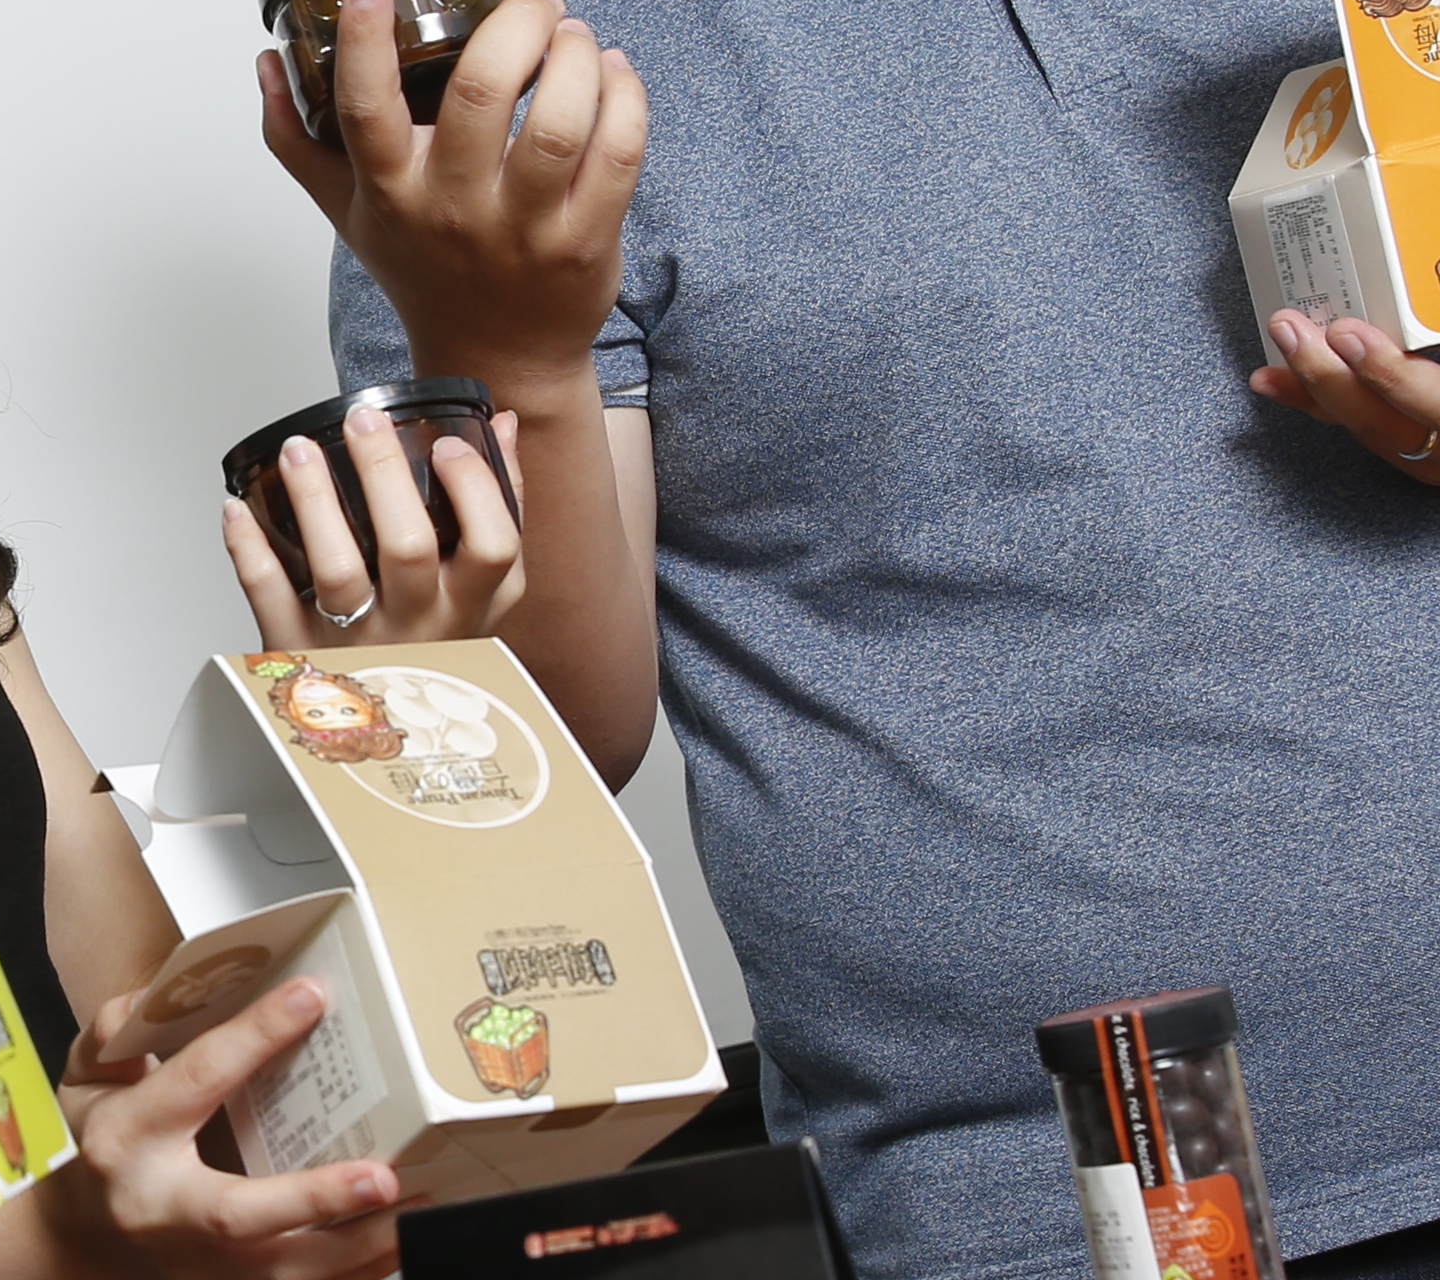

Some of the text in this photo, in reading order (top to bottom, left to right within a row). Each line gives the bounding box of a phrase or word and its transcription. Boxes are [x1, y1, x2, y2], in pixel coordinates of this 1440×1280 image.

[460, 787, 523, 802] Taiwan
[1115, 1037, 1136, 1091] chocolate
[1127, 1097, 1142, 1121] rice
[1134, 1134, 1155, 1188] chocolate
